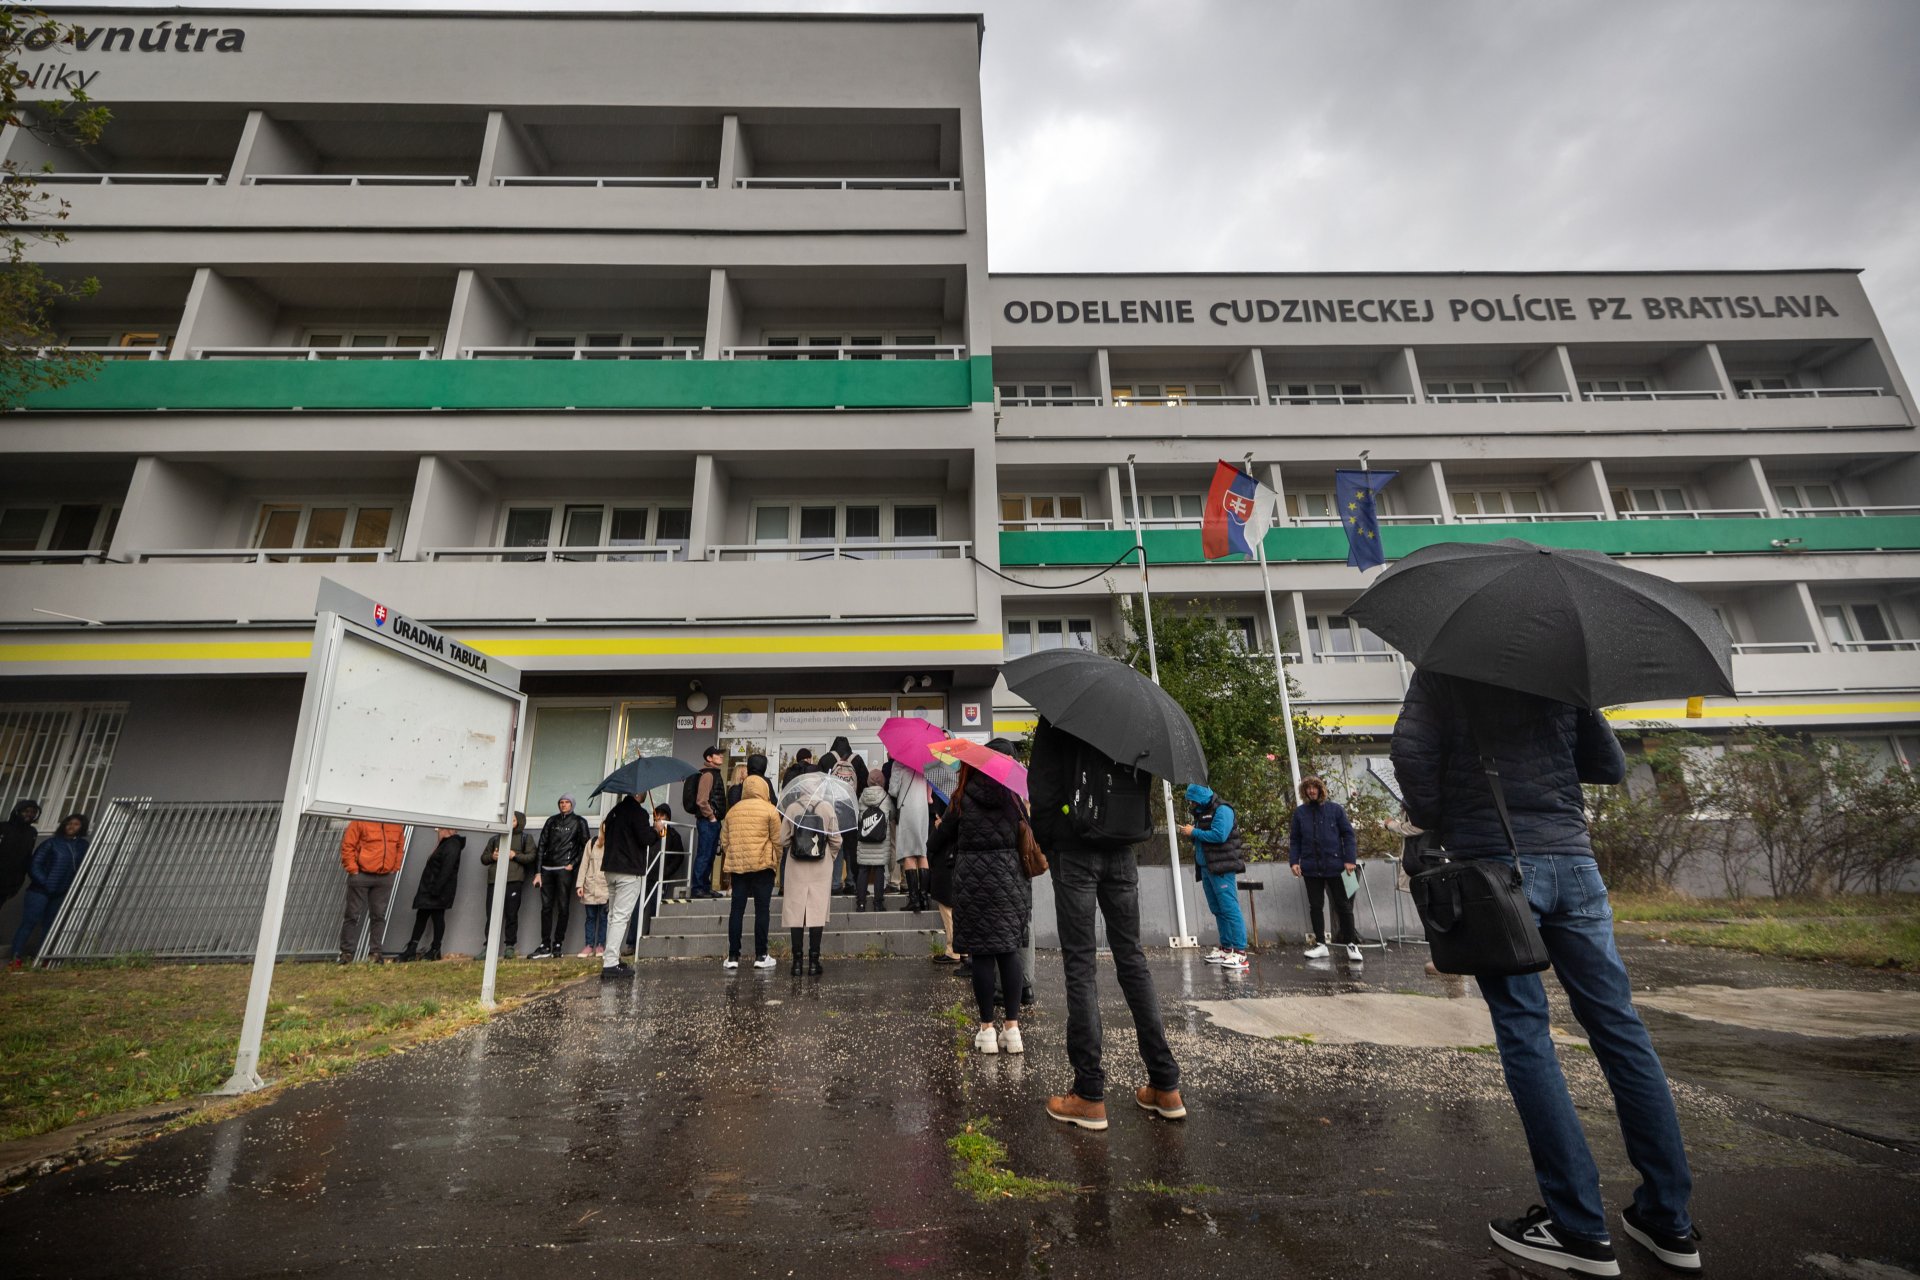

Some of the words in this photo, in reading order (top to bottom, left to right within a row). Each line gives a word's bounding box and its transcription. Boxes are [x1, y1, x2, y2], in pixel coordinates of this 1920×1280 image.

[74, 20, 246, 53] vnútra
[1003, 299, 1195, 324] ODDELENIE
[1209, 298, 1434, 326] CUDZINECKEJ
[1449, 294, 1577, 322] POLÍCIE
[1587, 297, 1632, 320] PZ
[1642, 294, 1840, 320] BRATISLAVA
[392, 615, 444, 655] ÚRADNÁ
[449, 642, 488, 674] TABUĽA
[700, 716, 707, 727] 4
[862, 812, 878, 829] NIKE
